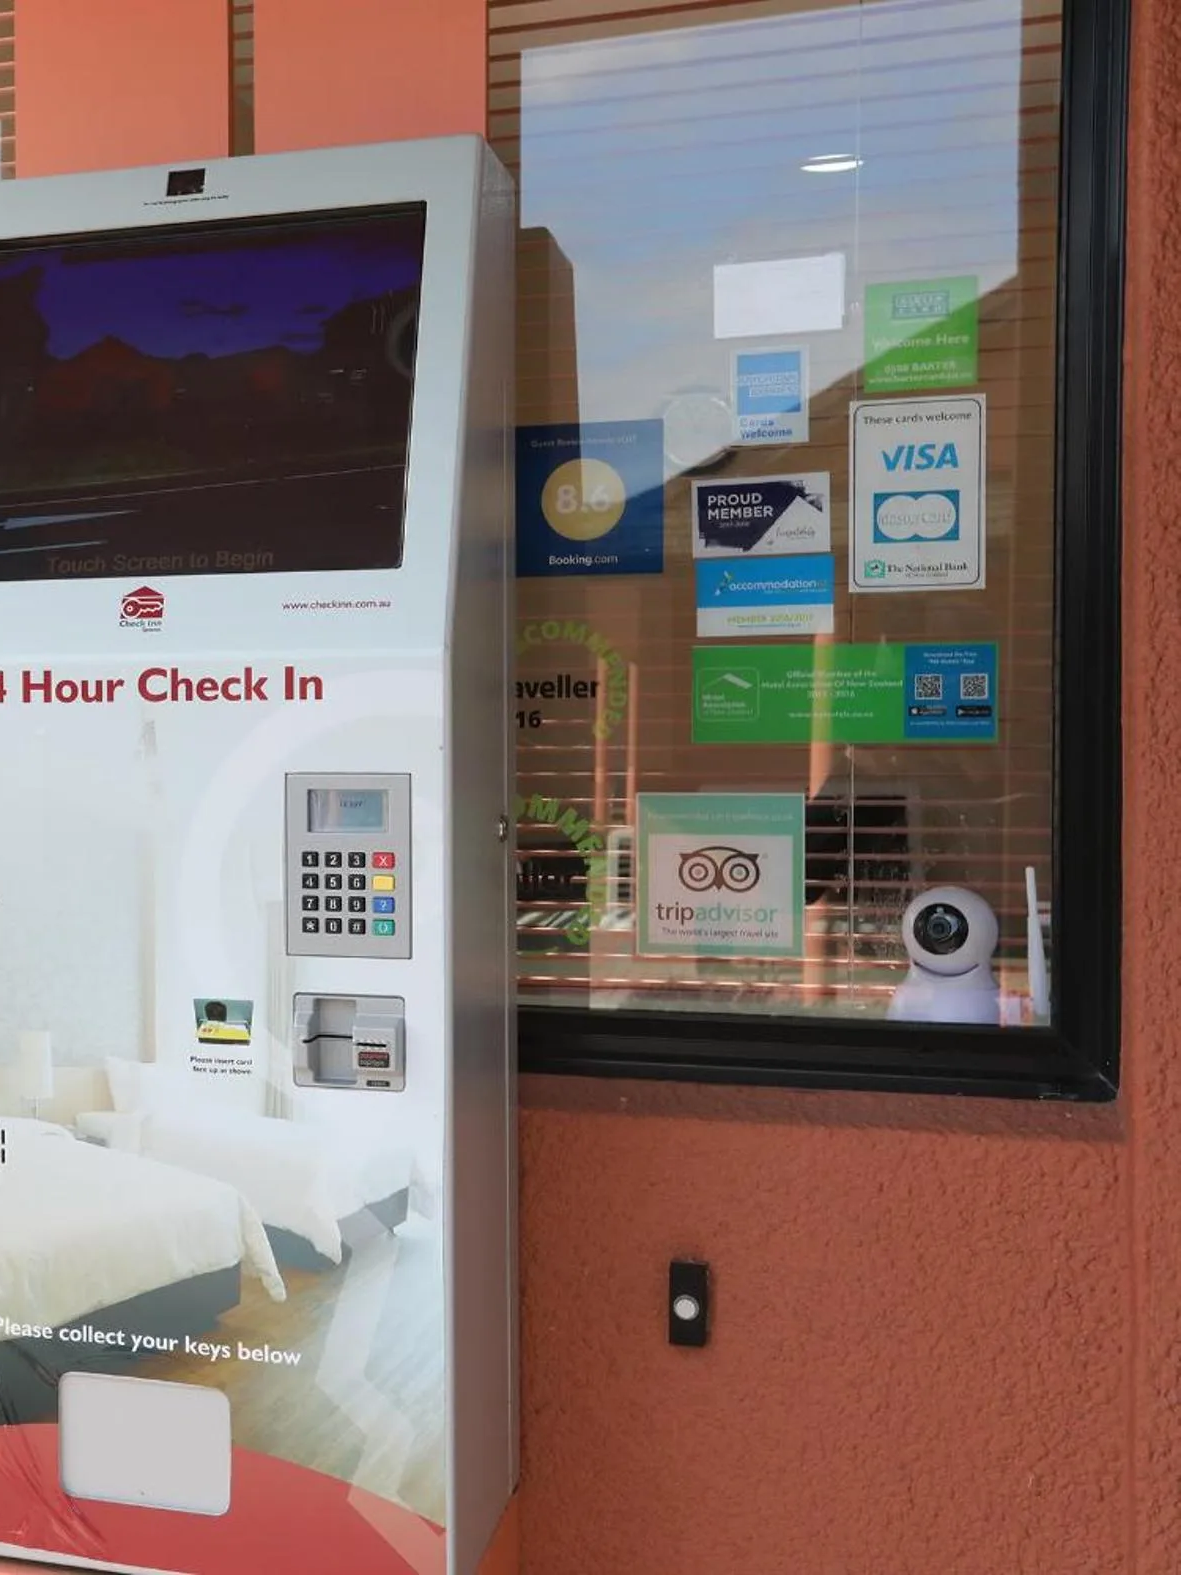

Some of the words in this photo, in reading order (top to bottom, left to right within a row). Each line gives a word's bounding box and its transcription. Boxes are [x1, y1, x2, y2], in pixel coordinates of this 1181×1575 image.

[936, 333, 969, 345] Here
[864, 415, 893, 425] These
[896, 413, 924, 423] cards
[926, 411, 972, 422] welcome
[881, 442, 959, 472] VISA
[556, 484, 610, 514] 8.6
[708, 493, 763, 506] PROUD
[708, 506, 774, 520] MEMBER
[47, 555, 106, 574] Touch
[113, 553, 183, 570] Screen
[190, 553, 208, 568] to
[216, 549, 273, 571] Begin
[549, 554, 618, 566] Booking.com
[888, 564, 903, 573] The
[905, 561, 943, 573] National
[945, 561, 968, 572] Bank
[282, 599, 391, 611] www.checkinn.com.au
[119, 620, 145, 628] Check
[22, 670, 125, 704] Hour
[138, 666, 269, 702] Check
[284, 665, 323, 701] In
[306, 854, 313, 866] 1
[330, 855, 337, 866] 2
[353, 855, 361, 866] 3
[306, 876, 314, 887] 4
[330, 876, 337, 888] 5
[353, 877, 361, 888] 6
[306, 898, 314, 909] 7
[330, 899, 337, 910] 8
[353, 900, 361, 911] 9
[655, 902, 778, 926] tripadvisor
[330, 921, 337, 932] 0
[662, 927, 678, 936] The
[678, 927, 709, 937] world's
[710, 929, 738, 939] largest
[739, 928, 763, 938] travel
[764, 929, 779, 939] site
[190, 1056, 213, 1065] Please
[214, 1057, 234, 1066] insert
[236, 1058, 253, 1066] card
[193, 1065, 208, 1073] face
[209, 1067, 218, 1075] up
[229, 1067, 252, 1075] shown
[59, 1325, 126, 1347] collect
[131, 1334, 179, 1353] your
[185, 1335, 231, 1362] keys
[238, 1342, 302, 1366] below
